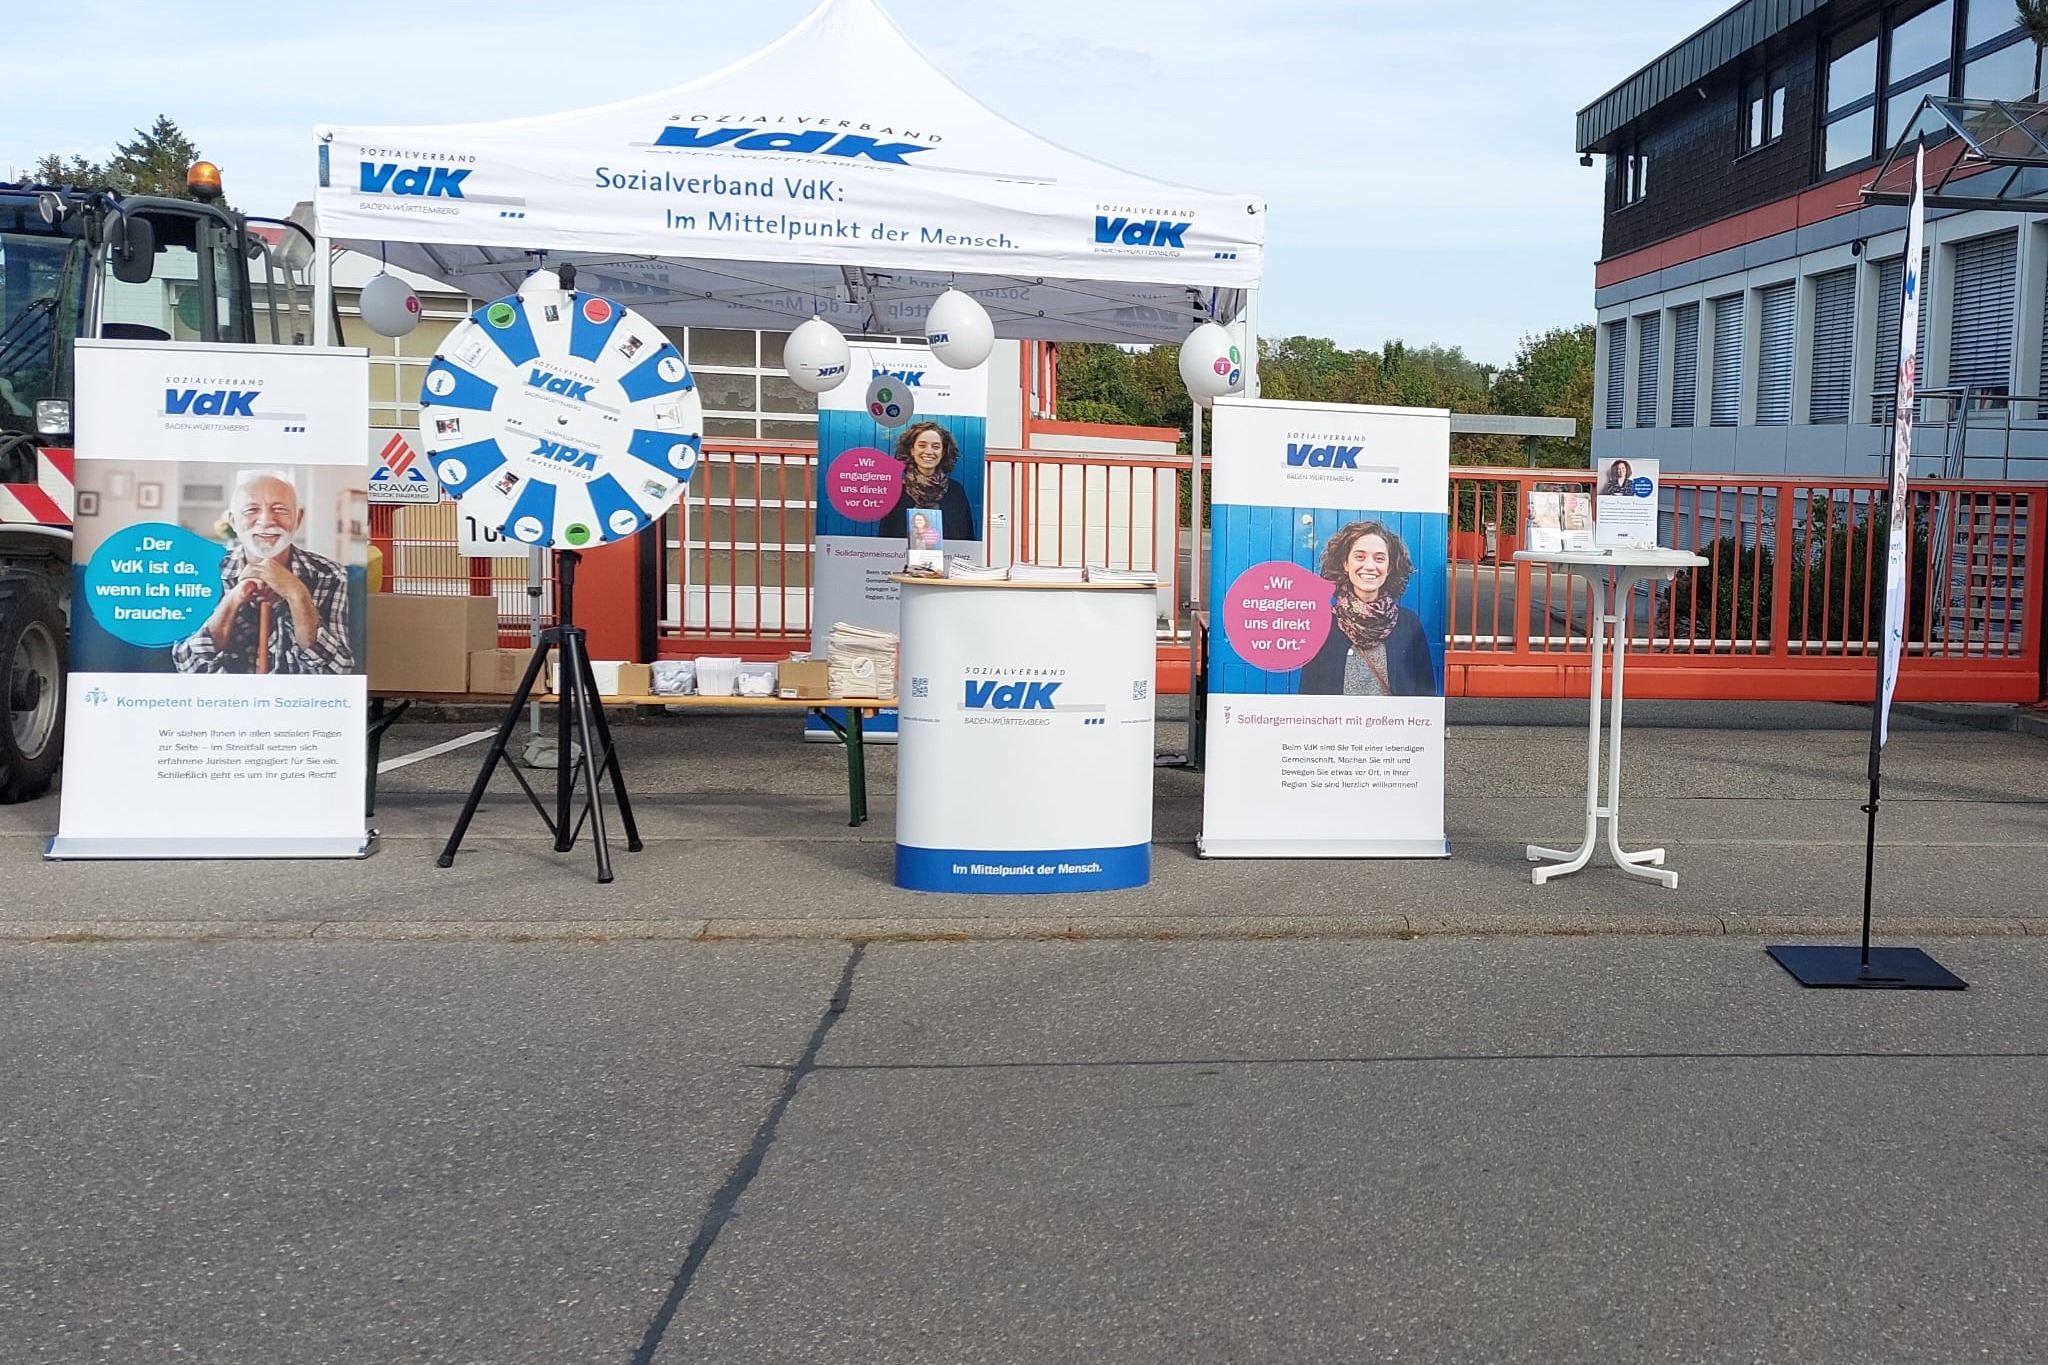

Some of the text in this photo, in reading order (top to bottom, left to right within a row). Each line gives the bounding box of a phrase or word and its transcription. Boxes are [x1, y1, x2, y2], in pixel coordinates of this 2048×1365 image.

[668, 115, 943, 143] SOZIALVERBAND
[653, 126, 937, 166] VdK
[360, 147, 477, 163] SOZIALVERBAND
[360, 161, 473, 199] VdK
[595, 167, 845, 202] Sozialverband VdK:
[360, 202, 460, 216] BADEN-WÜRTTEMBERG
[1096, 204, 1196, 218] SOZIALVERBAND
[666, 208, 1020, 250] Im Mittelpunkt der Mensch.
[1095, 215, 1193, 249] VdK
[816, 364, 845, 377] VdK
[165, 375, 264, 386] SOZIALVERBAND
[528, 367, 595, 402] VdK
[165, 388, 263, 417] VdK
[164, 422, 250, 432] BADEN-WÜRTTEMBERG
[1287, 432, 1366, 442] SOZIALVERBAND
[529, 439, 597, 471] VdK
[1287, 443, 1365, 469] VdK
[839, 472, 891, 483] engagieren
[368, 483, 429, 493] KRAVAG
[840, 484, 887, 495] uns direkt
[845, 500, 860, 508] vor
[135, 537, 173, 553] „Der
[110, 559, 199, 576] VdK ist da,
[1263, 576, 1293, 590] „Wir
[96, 583, 212, 598] wenn ich Hilfe
[1242, 598, 1316, 611] engagieren
[1244, 618, 1310, 631] uns direkt
[1251, 640, 1271, 650] vor
[964, 667, 1067, 676] SOZIALVERBAND
[964, 680, 1063, 710] VdK
[117, 696, 351, 711] Kompetent beraten im Sozialrecht.
[963, 717, 1050, 726] BADEN-WÜRTTEMBERG
[1237, 714, 1433, 728] Solidargemeinschaft mit großem Herz.
[159, 729, 342, 740] Wir stehen Ihnen in allen sozialen Fragen
[175, 743, 198, 751] Seite
[211, 743, 222, 751] im
[226, 743, 264, 751] Streitfall
[267, 743, 297, 751] setzen
[300, 743, 318, 751] sich
[952, 863, 1102, 877] Im Mittelpunkt der Mensch.
